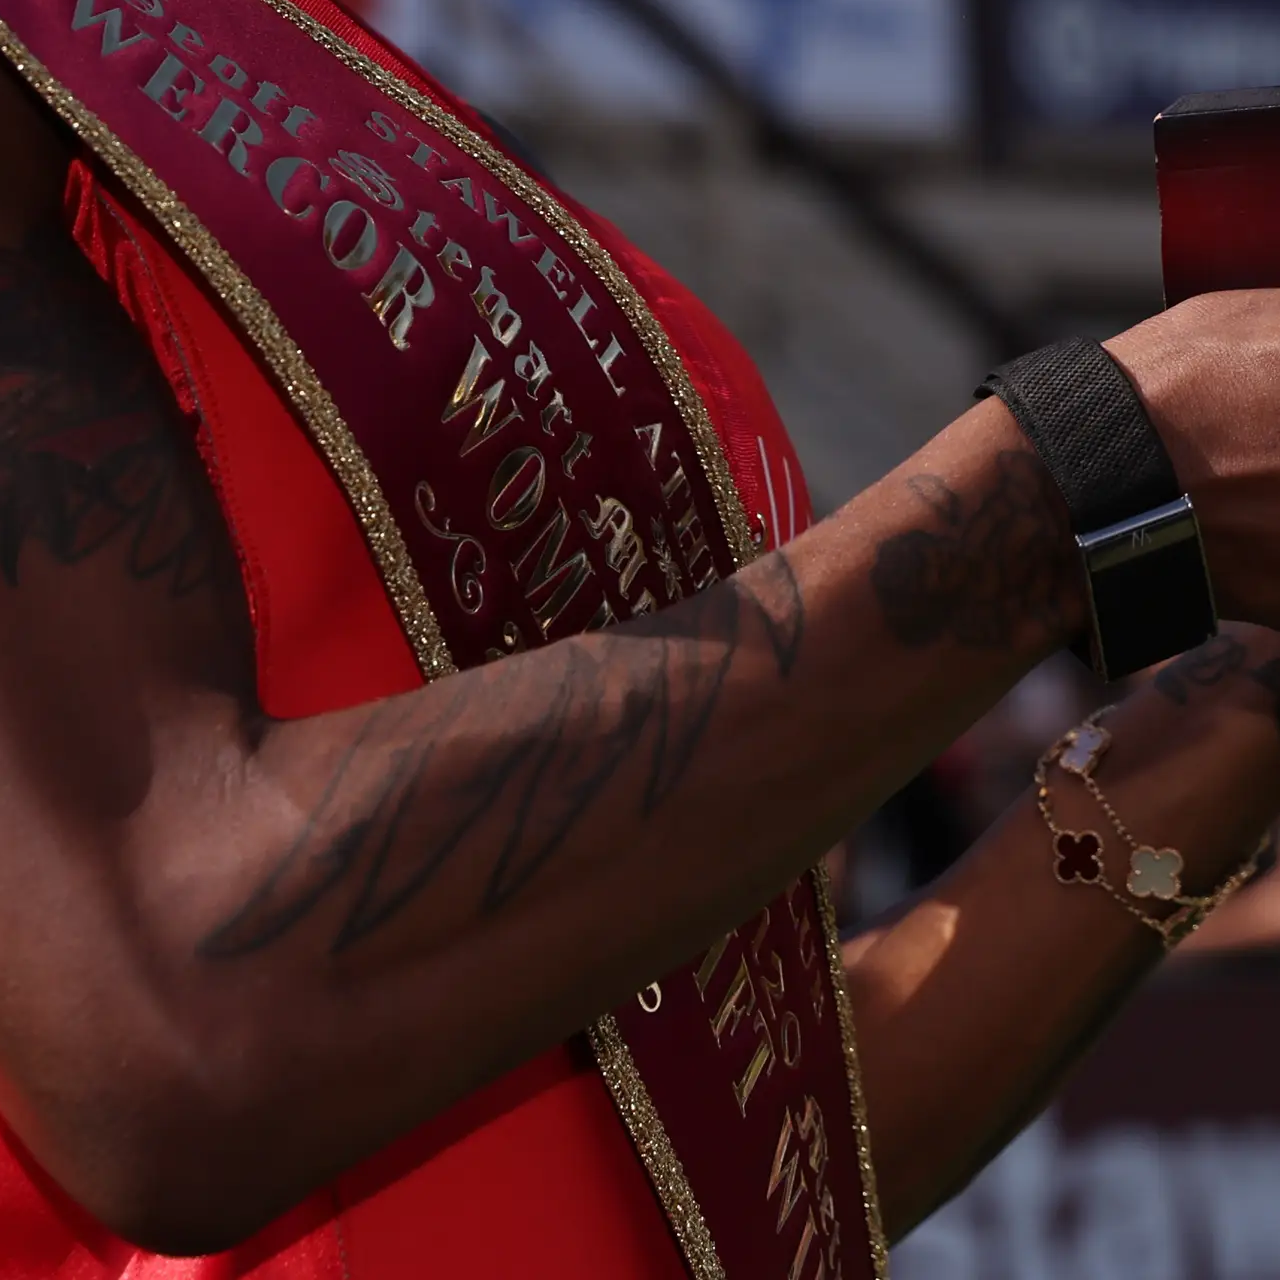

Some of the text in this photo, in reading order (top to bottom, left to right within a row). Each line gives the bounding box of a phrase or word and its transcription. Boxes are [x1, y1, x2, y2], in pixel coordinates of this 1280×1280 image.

[328, 149, 595, 480] Stewart
[364, 110, 626, 397] STAWELL
[693, 928, 777, 1118] IFT
